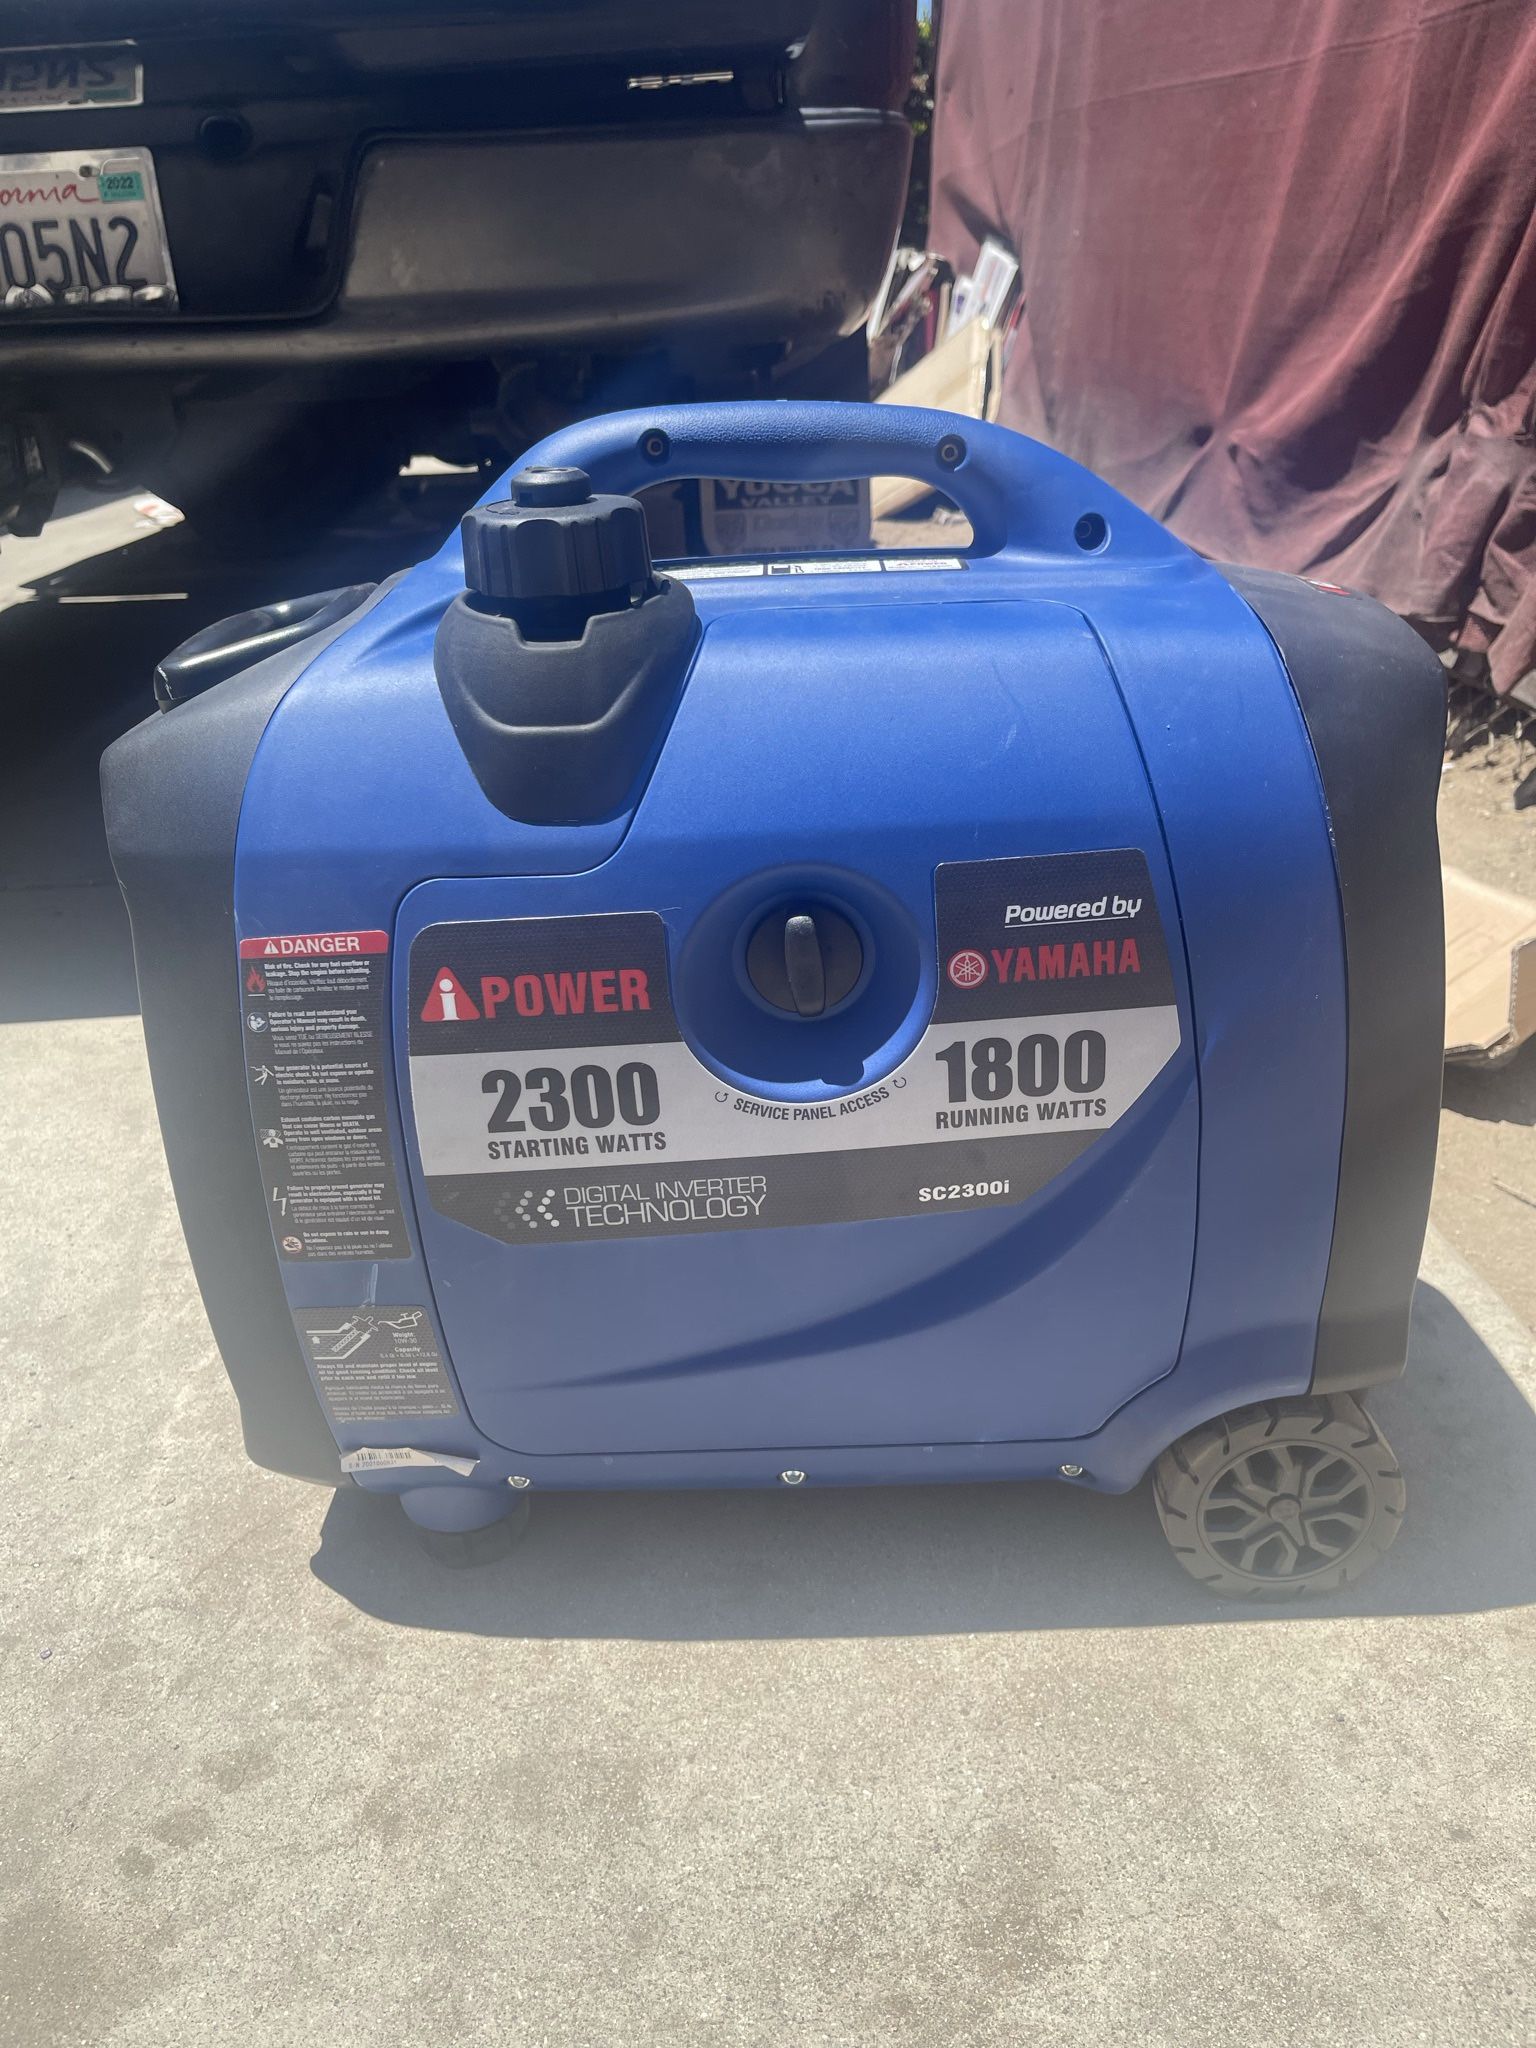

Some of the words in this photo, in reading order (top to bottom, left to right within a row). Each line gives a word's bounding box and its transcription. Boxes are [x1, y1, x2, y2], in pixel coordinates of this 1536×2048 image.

[106, 176, 135, 190] 2022
[1004, 896, 1107, 924] Powered
[1111, 895, 1142, 918] by
[280, 937, 360, 954] DANGER
[991, 938, 1141, 985] YAMAHA
[935, 1029, 1107, 1103] 1800
[481, 1061, 661, 1134] 2300
[733, 1098, 789, 1121] SERVICE
[793, 1107, 837, 1121] PANEL
[839, 1086, 890, 1116] ACCESS
[935, 1105, 1029, 1130] RUNNING
[1038, 1098, 1107, 1121] WATTS
[488, 1134, 589, 1160] STARTING
[595, 1131, 667, 1154] WATTS
[563, 1183, 650, 1205] DIGITAL
[655, 1175, 767, 1200] INVERTER
[918, 1180, 1010, 1202] SC2300i
[566, 1194, 767, 1227] TECHNOLOGY
